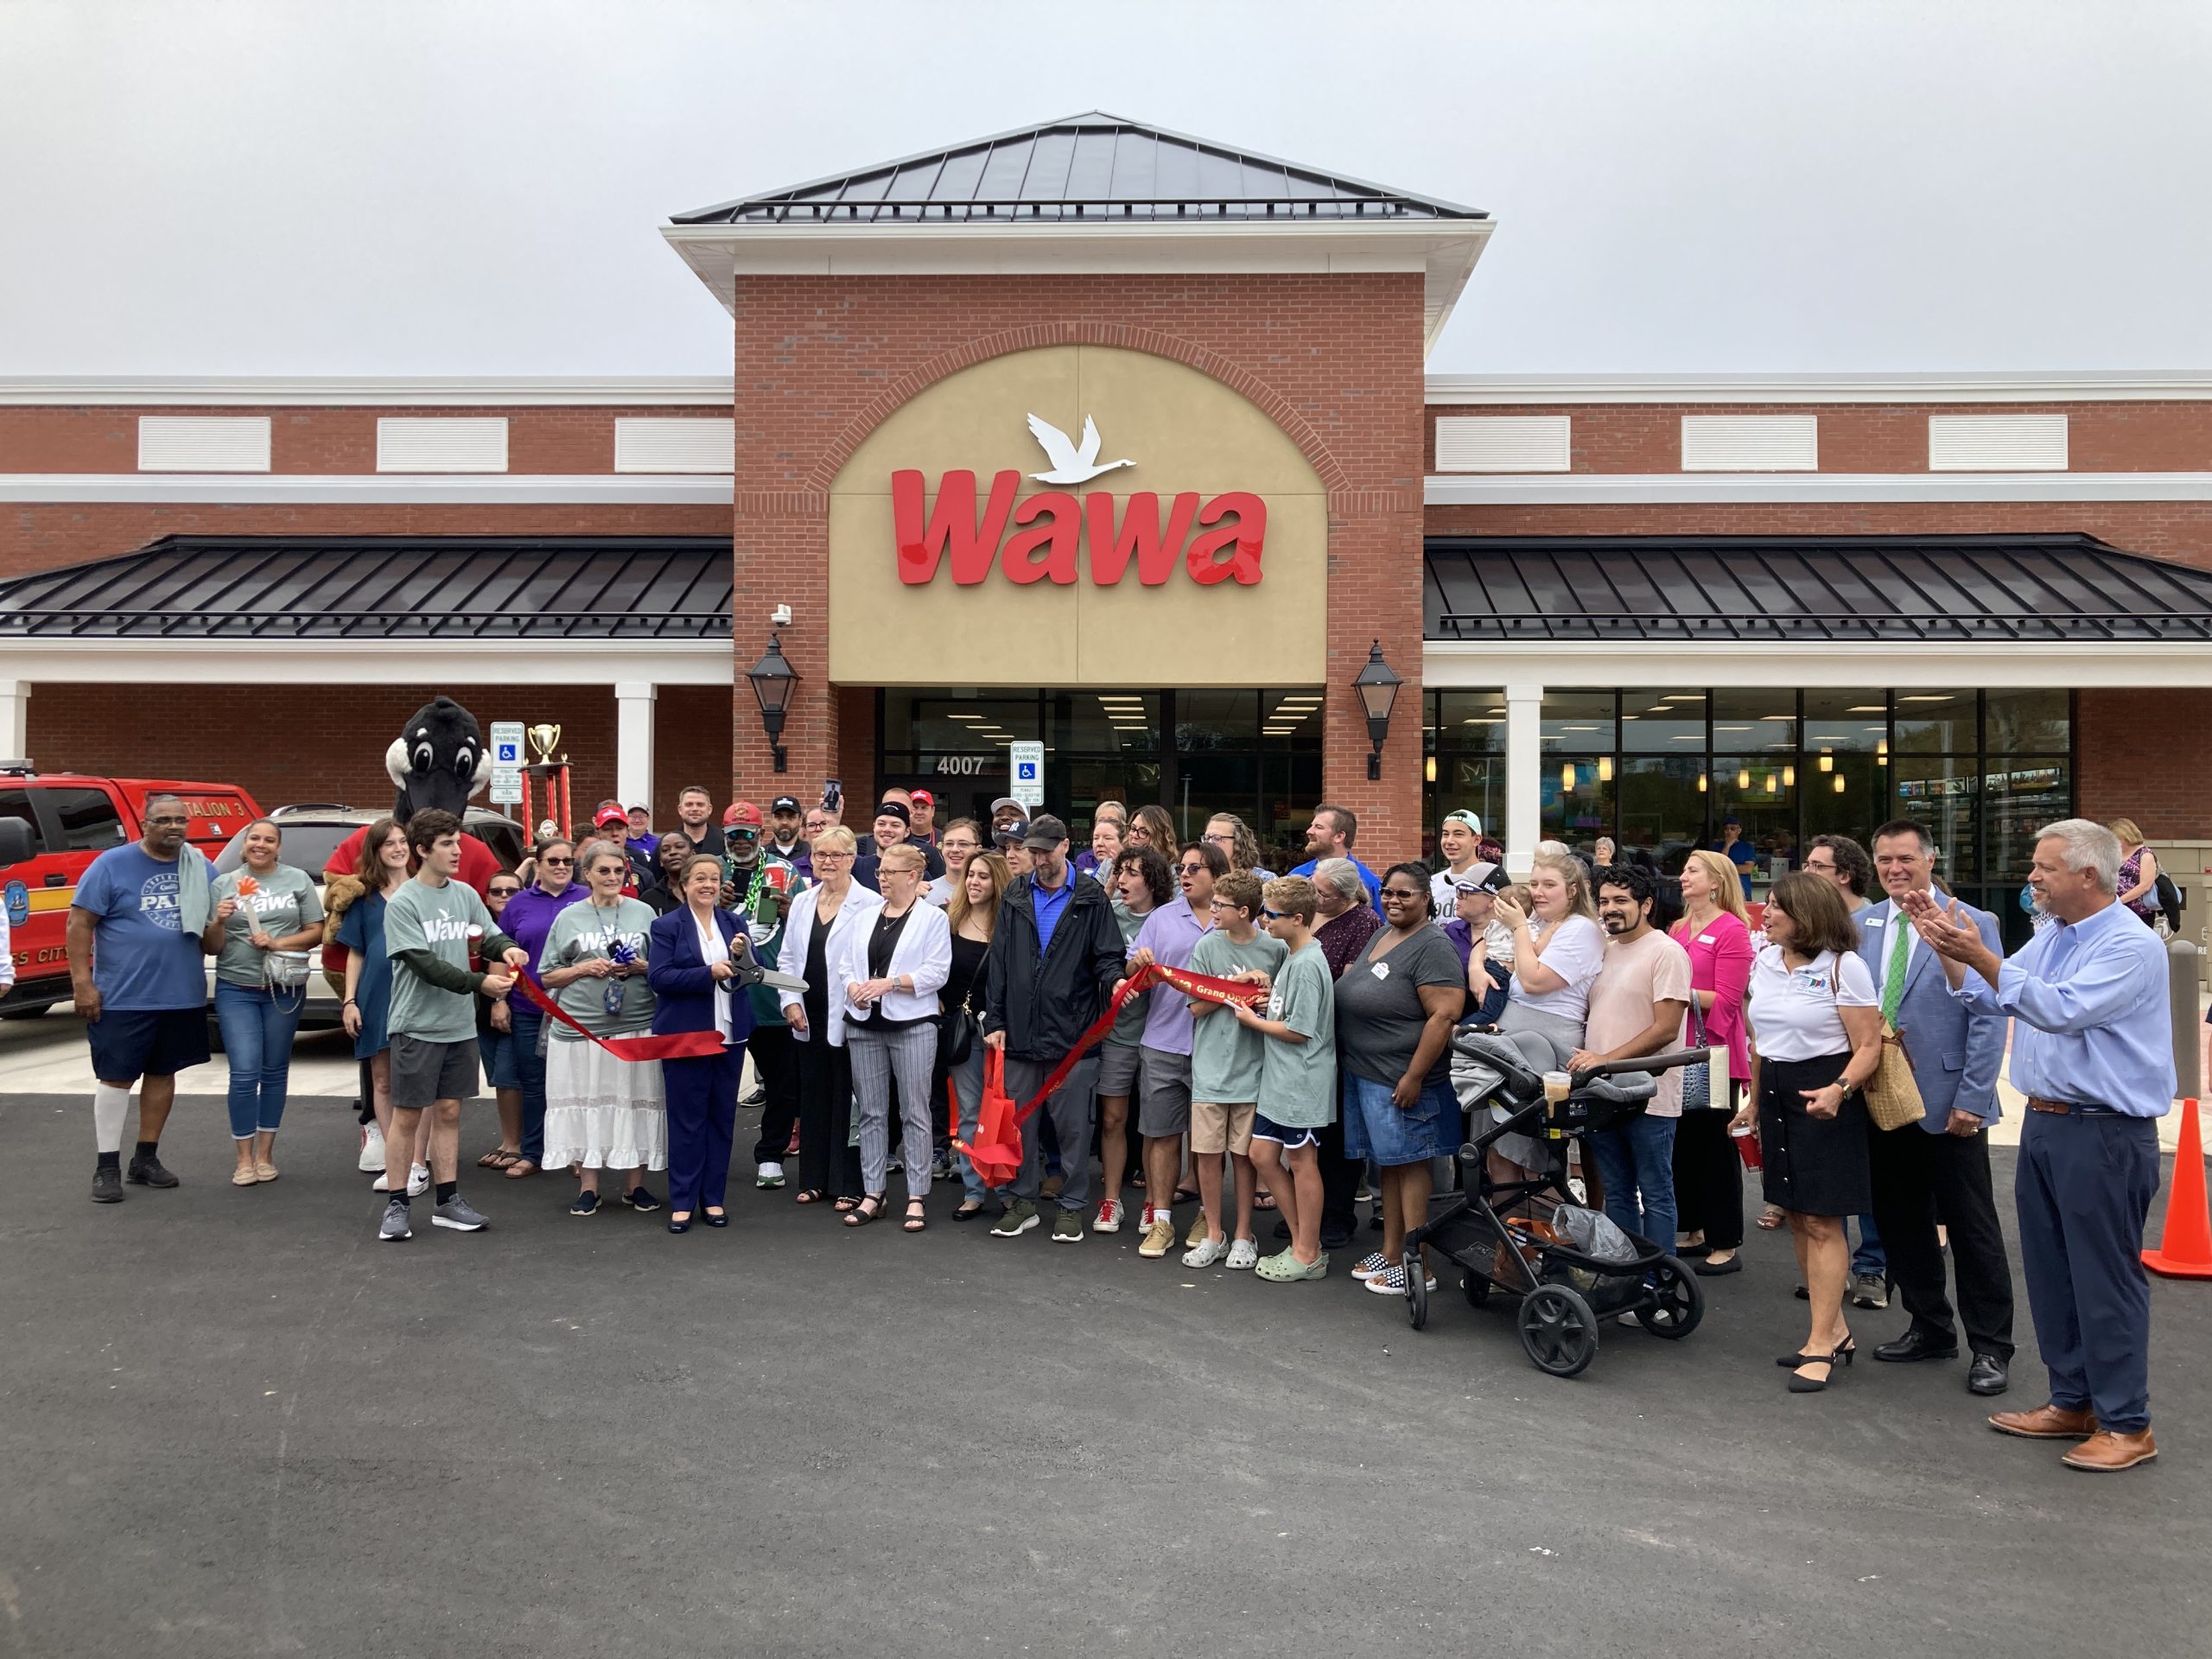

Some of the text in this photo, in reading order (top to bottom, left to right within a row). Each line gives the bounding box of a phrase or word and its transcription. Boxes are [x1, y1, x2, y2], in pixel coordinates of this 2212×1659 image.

[891, 469, 1268, 586] Wawa
[938, 756, 984, 775] 4007
[183, 802, 244, 817] TALION 3
[139, 893, 181, 912] PA
[423, 918, 470, 943] Waw
[1196, 984, 1225, 999] Grand
